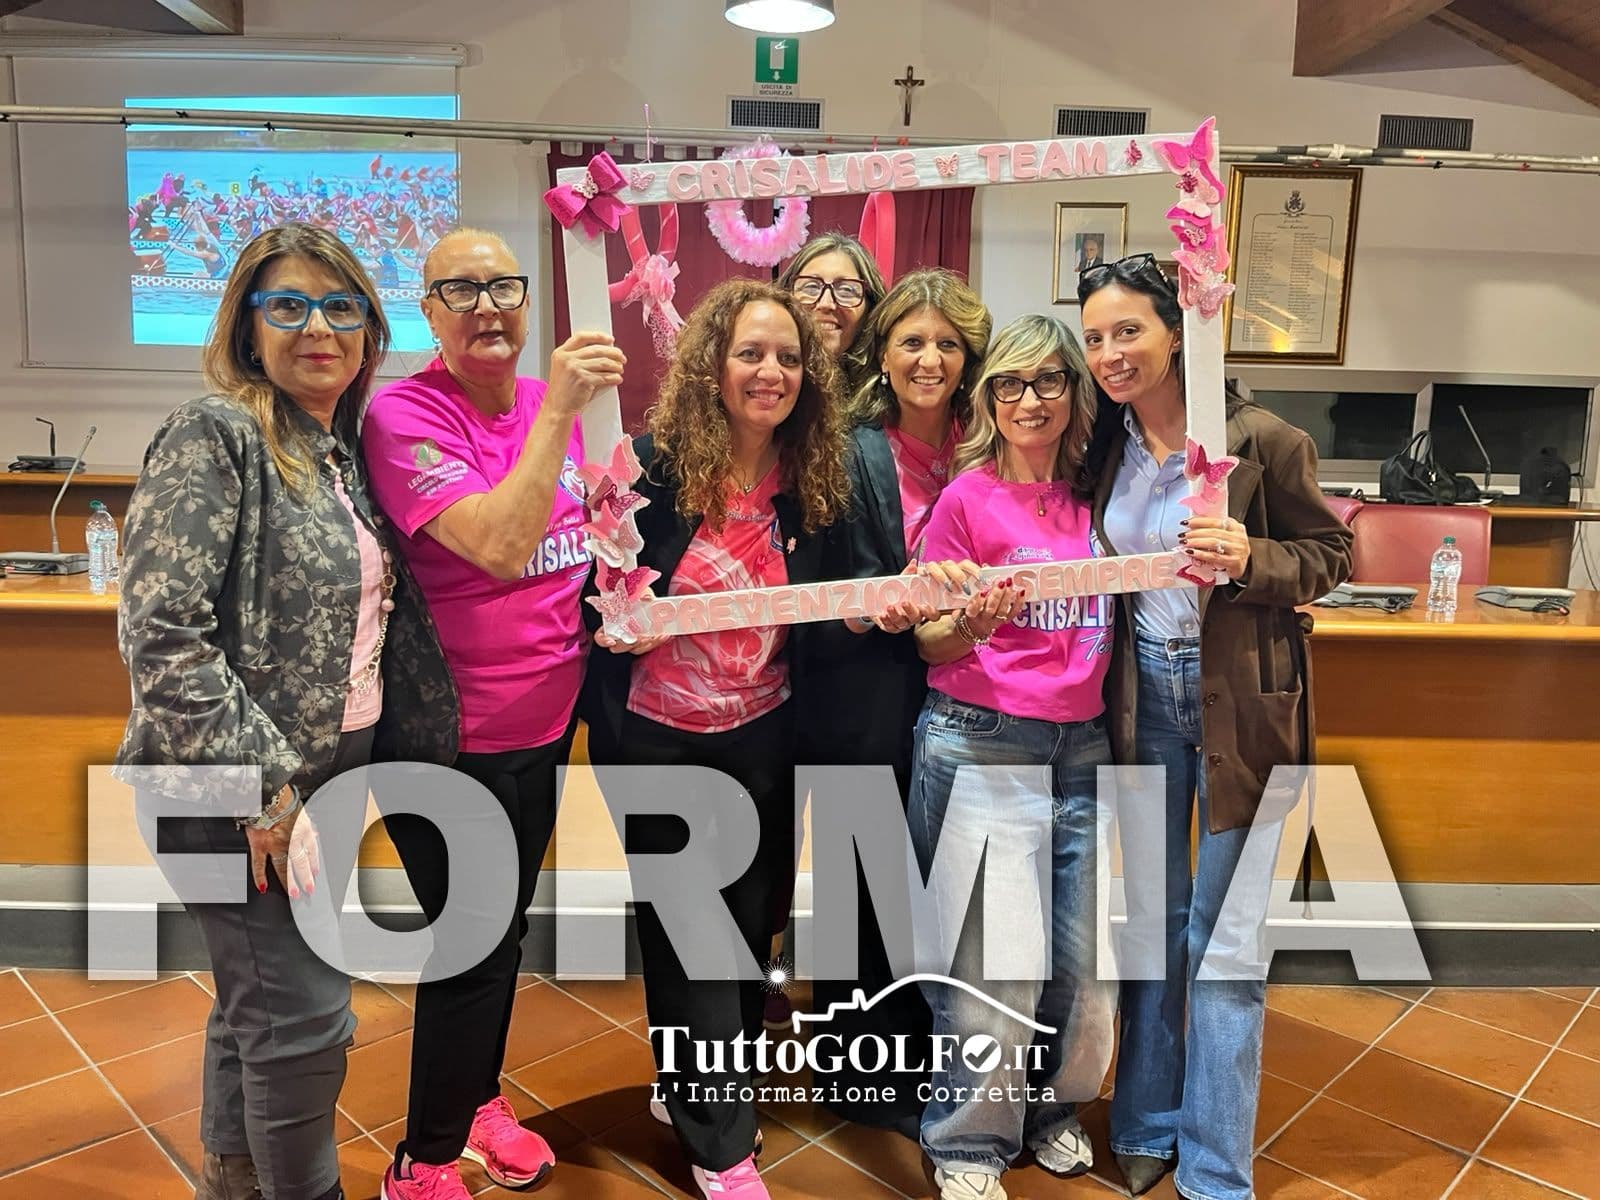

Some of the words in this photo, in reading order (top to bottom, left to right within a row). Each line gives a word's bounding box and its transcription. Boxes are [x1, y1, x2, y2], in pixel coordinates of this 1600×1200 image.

[231, 183, 240, 194] 8
[667, 152, 919, 200] CRISALIDE
[977, 140, 1108, 182] TEAM
[1013, 555, 1176, 601] SEMPRE
